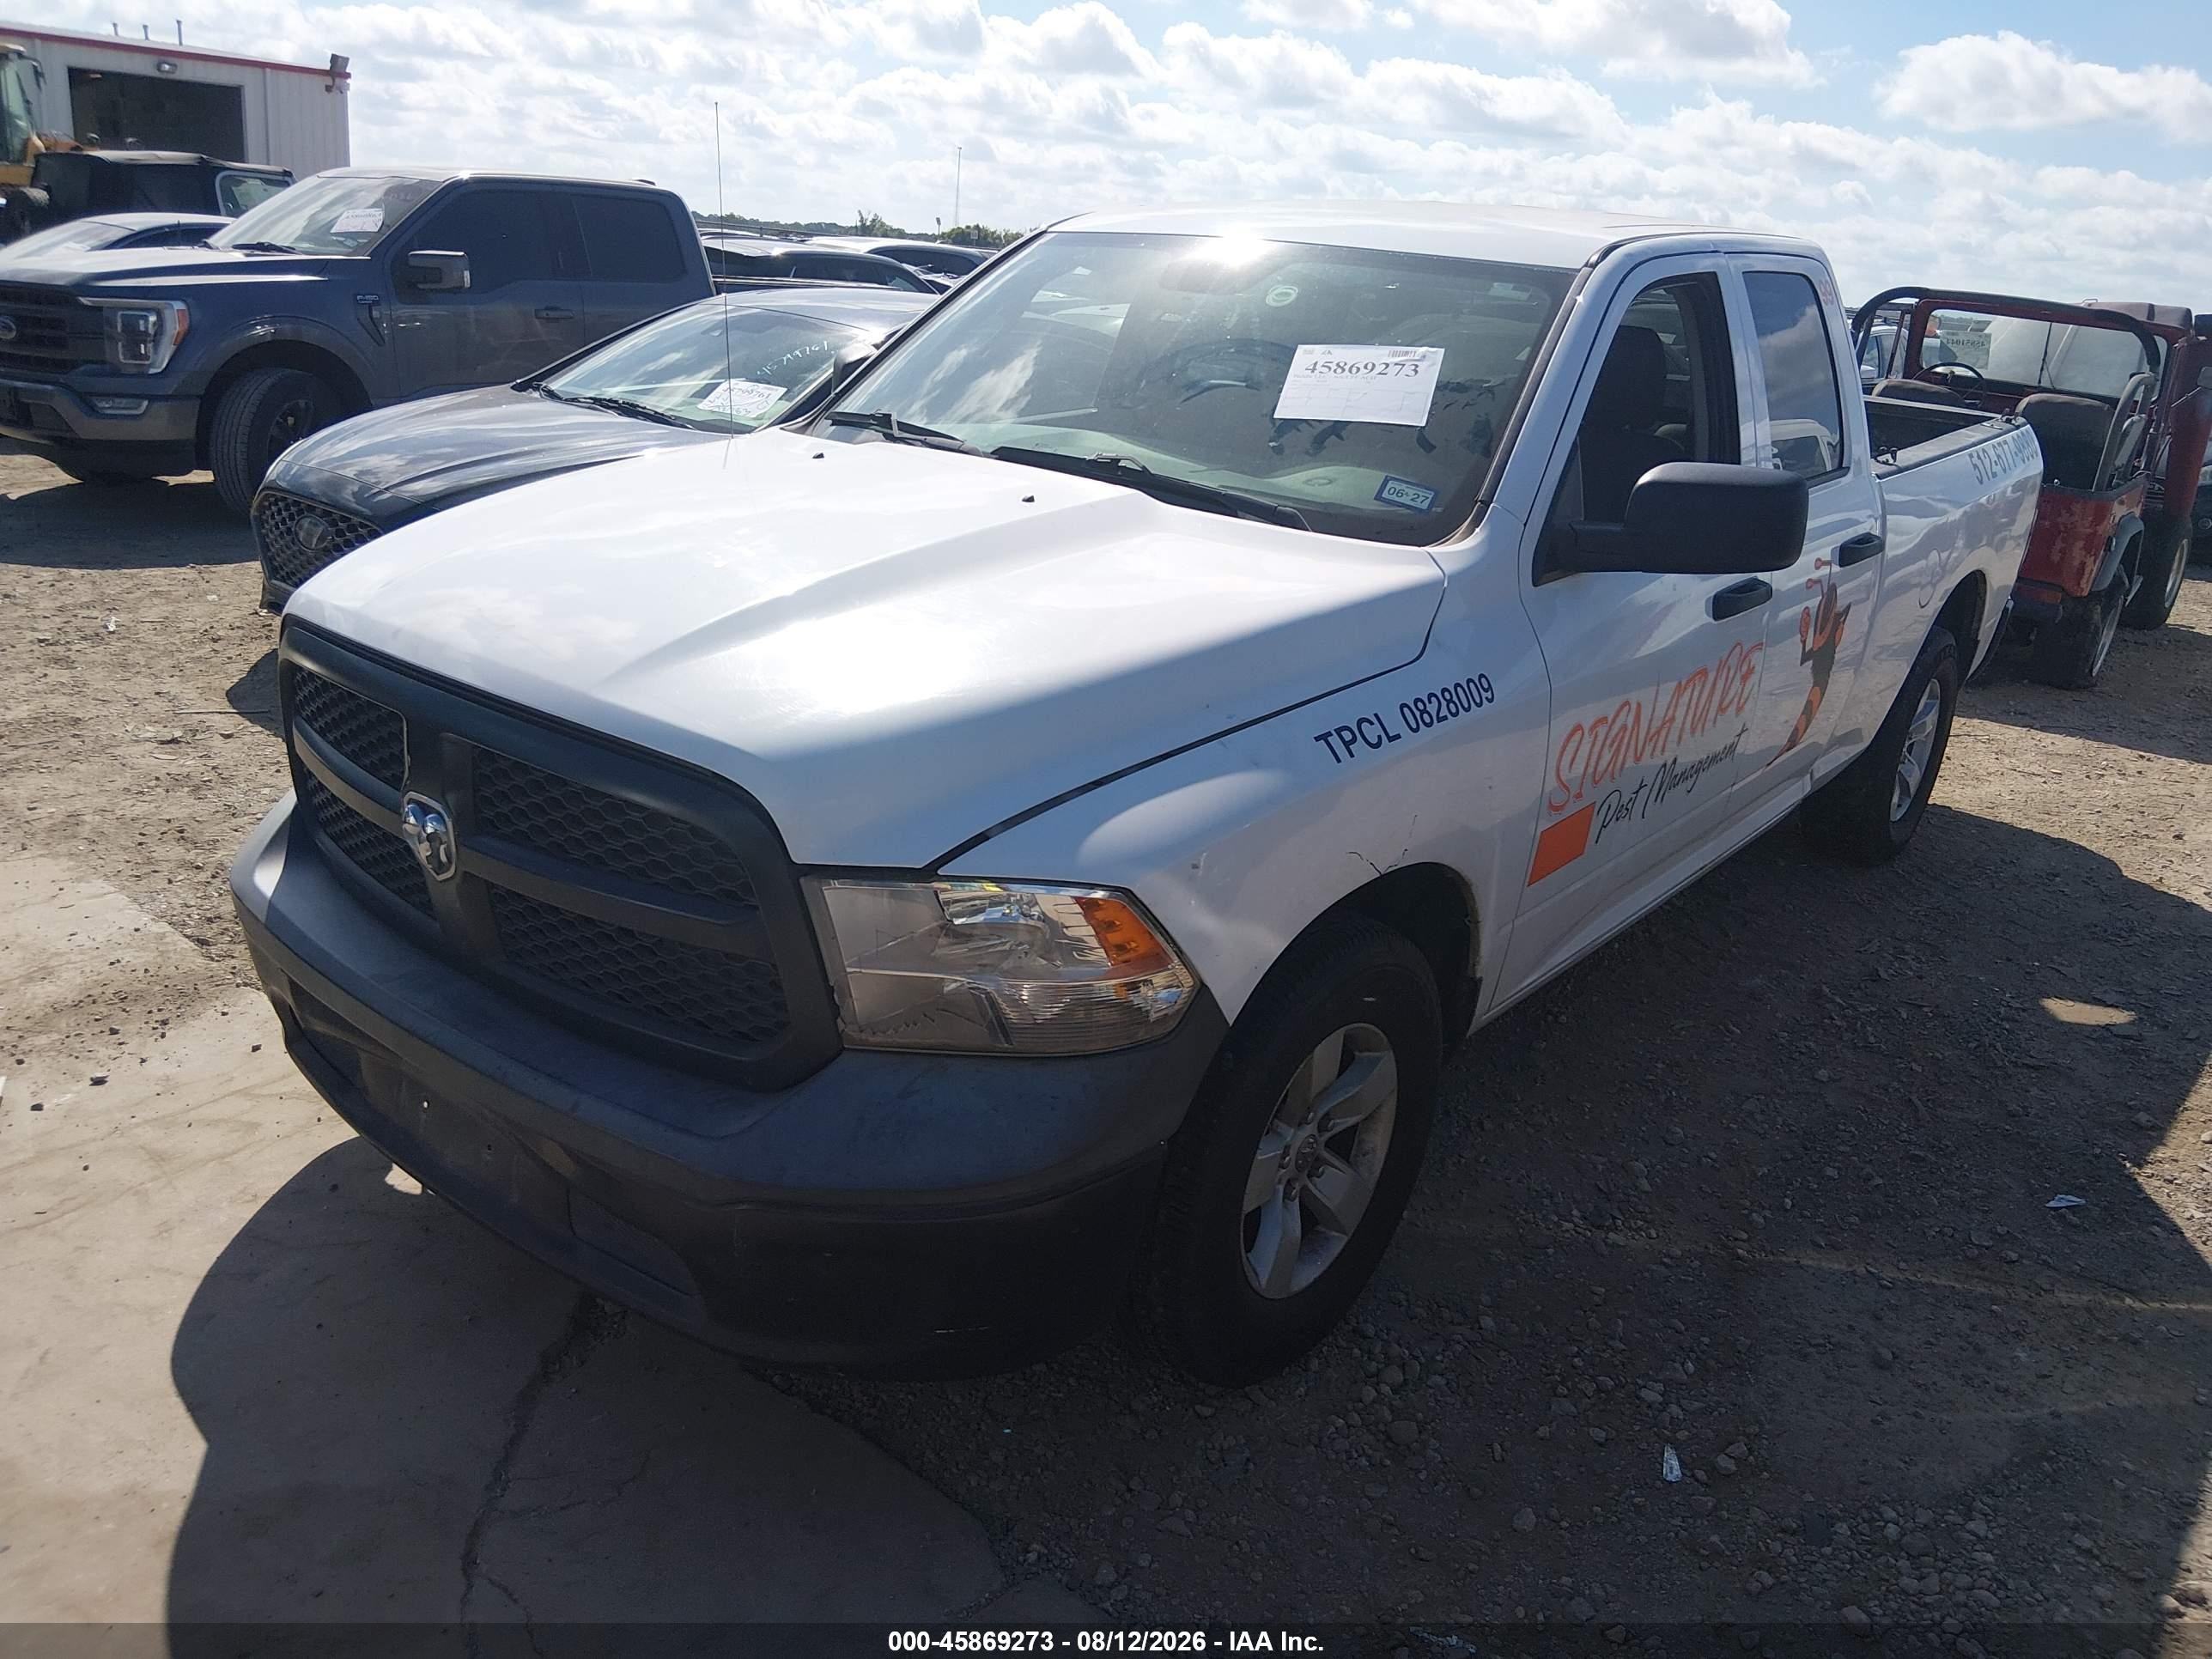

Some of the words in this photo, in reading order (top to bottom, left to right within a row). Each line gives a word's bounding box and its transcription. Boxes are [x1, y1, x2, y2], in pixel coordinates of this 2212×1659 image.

[1305, 361, 1419, 378] 45869273
[1313, 712, 1402, 763] TPCL
[1399, 672, 1495, 733] 0828009
[1547, 641, 1764, 817] SIGNATURE
[1595, 775, 1647, 844] Pest
[1644, 723, 1748, 819] Management
